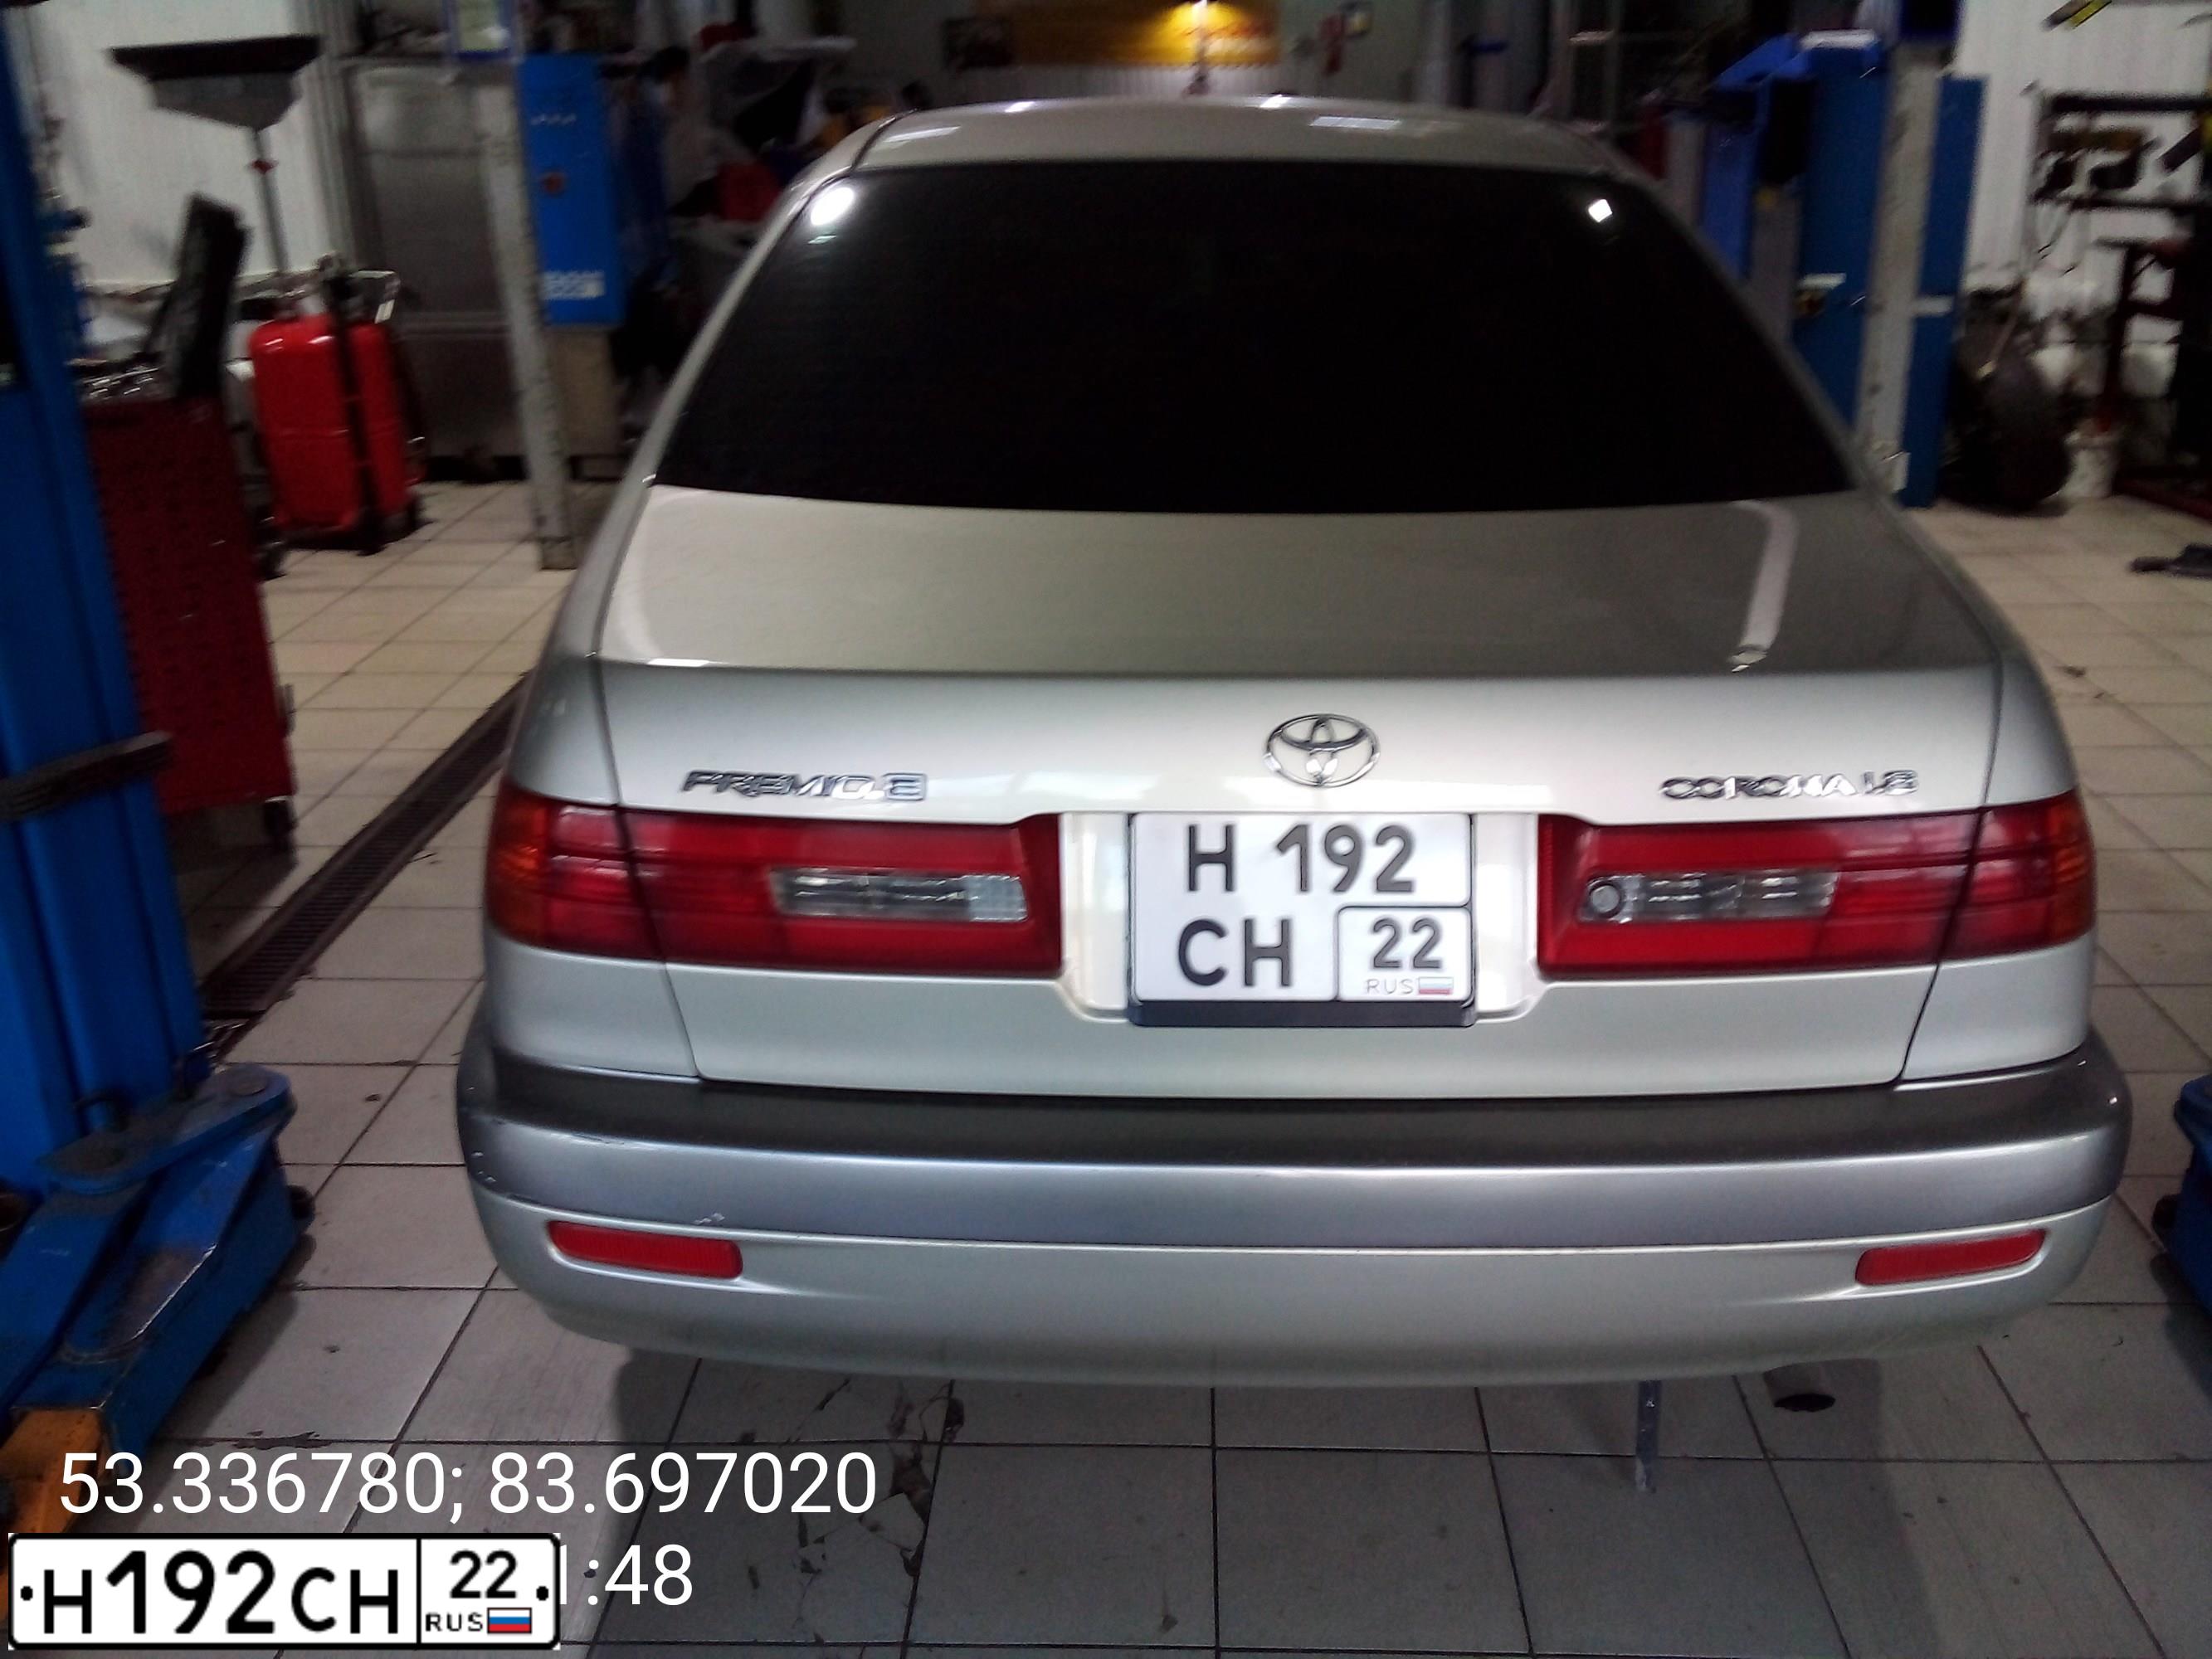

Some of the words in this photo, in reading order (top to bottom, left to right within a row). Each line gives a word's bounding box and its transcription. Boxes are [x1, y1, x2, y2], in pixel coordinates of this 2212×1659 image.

[1275, 823, 1414, 893] 192
[1372, 917, 1442, 970] 22
[1367, 979, 1413, 995] RUS
